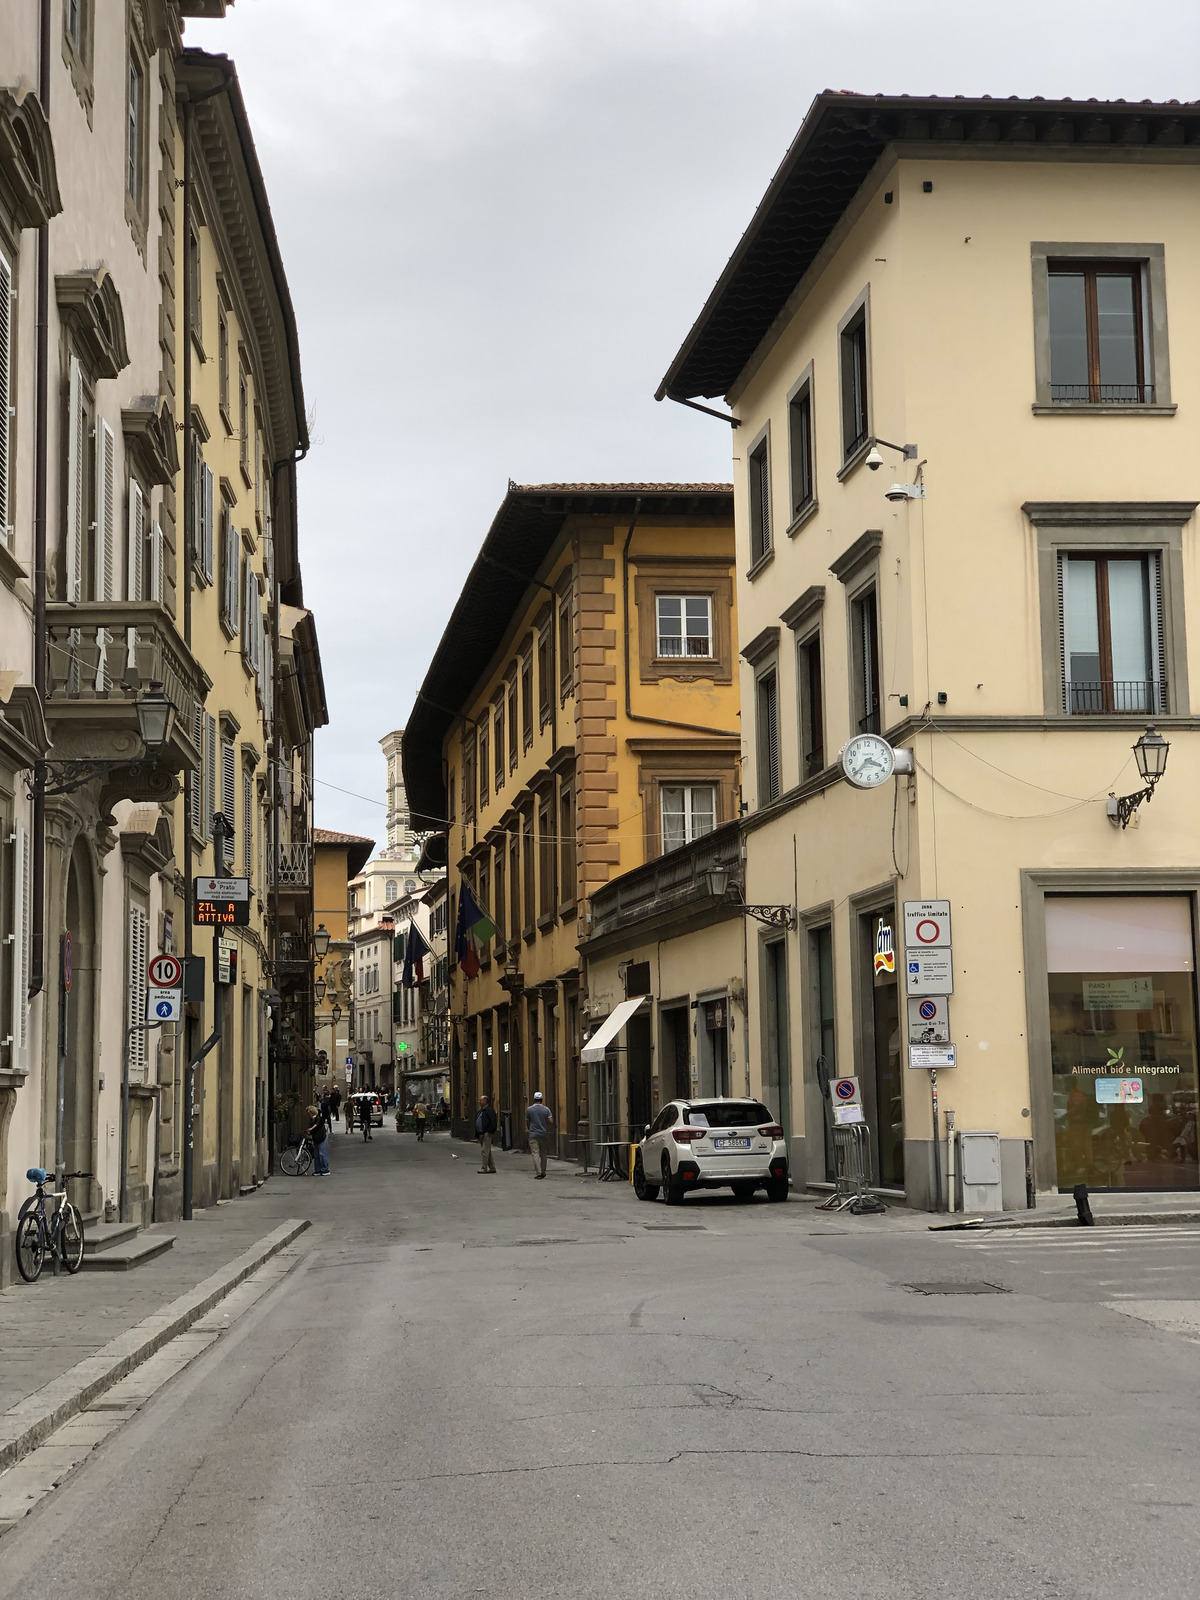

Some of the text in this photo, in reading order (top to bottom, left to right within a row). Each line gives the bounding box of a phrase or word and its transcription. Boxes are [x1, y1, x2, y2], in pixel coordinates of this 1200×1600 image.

[198, 902, 235, 912] ZTL A
[198, 913, 235, 922] ATTIVA
[877, 917, 891, 953] dm
[157, 962, 173, 979] 10
[1071, 1065, 1107, 1074] Alimenti
[1110, 1065, 1124, 1074] bio
[1134, 1065, 1180, 1076] Integratori
